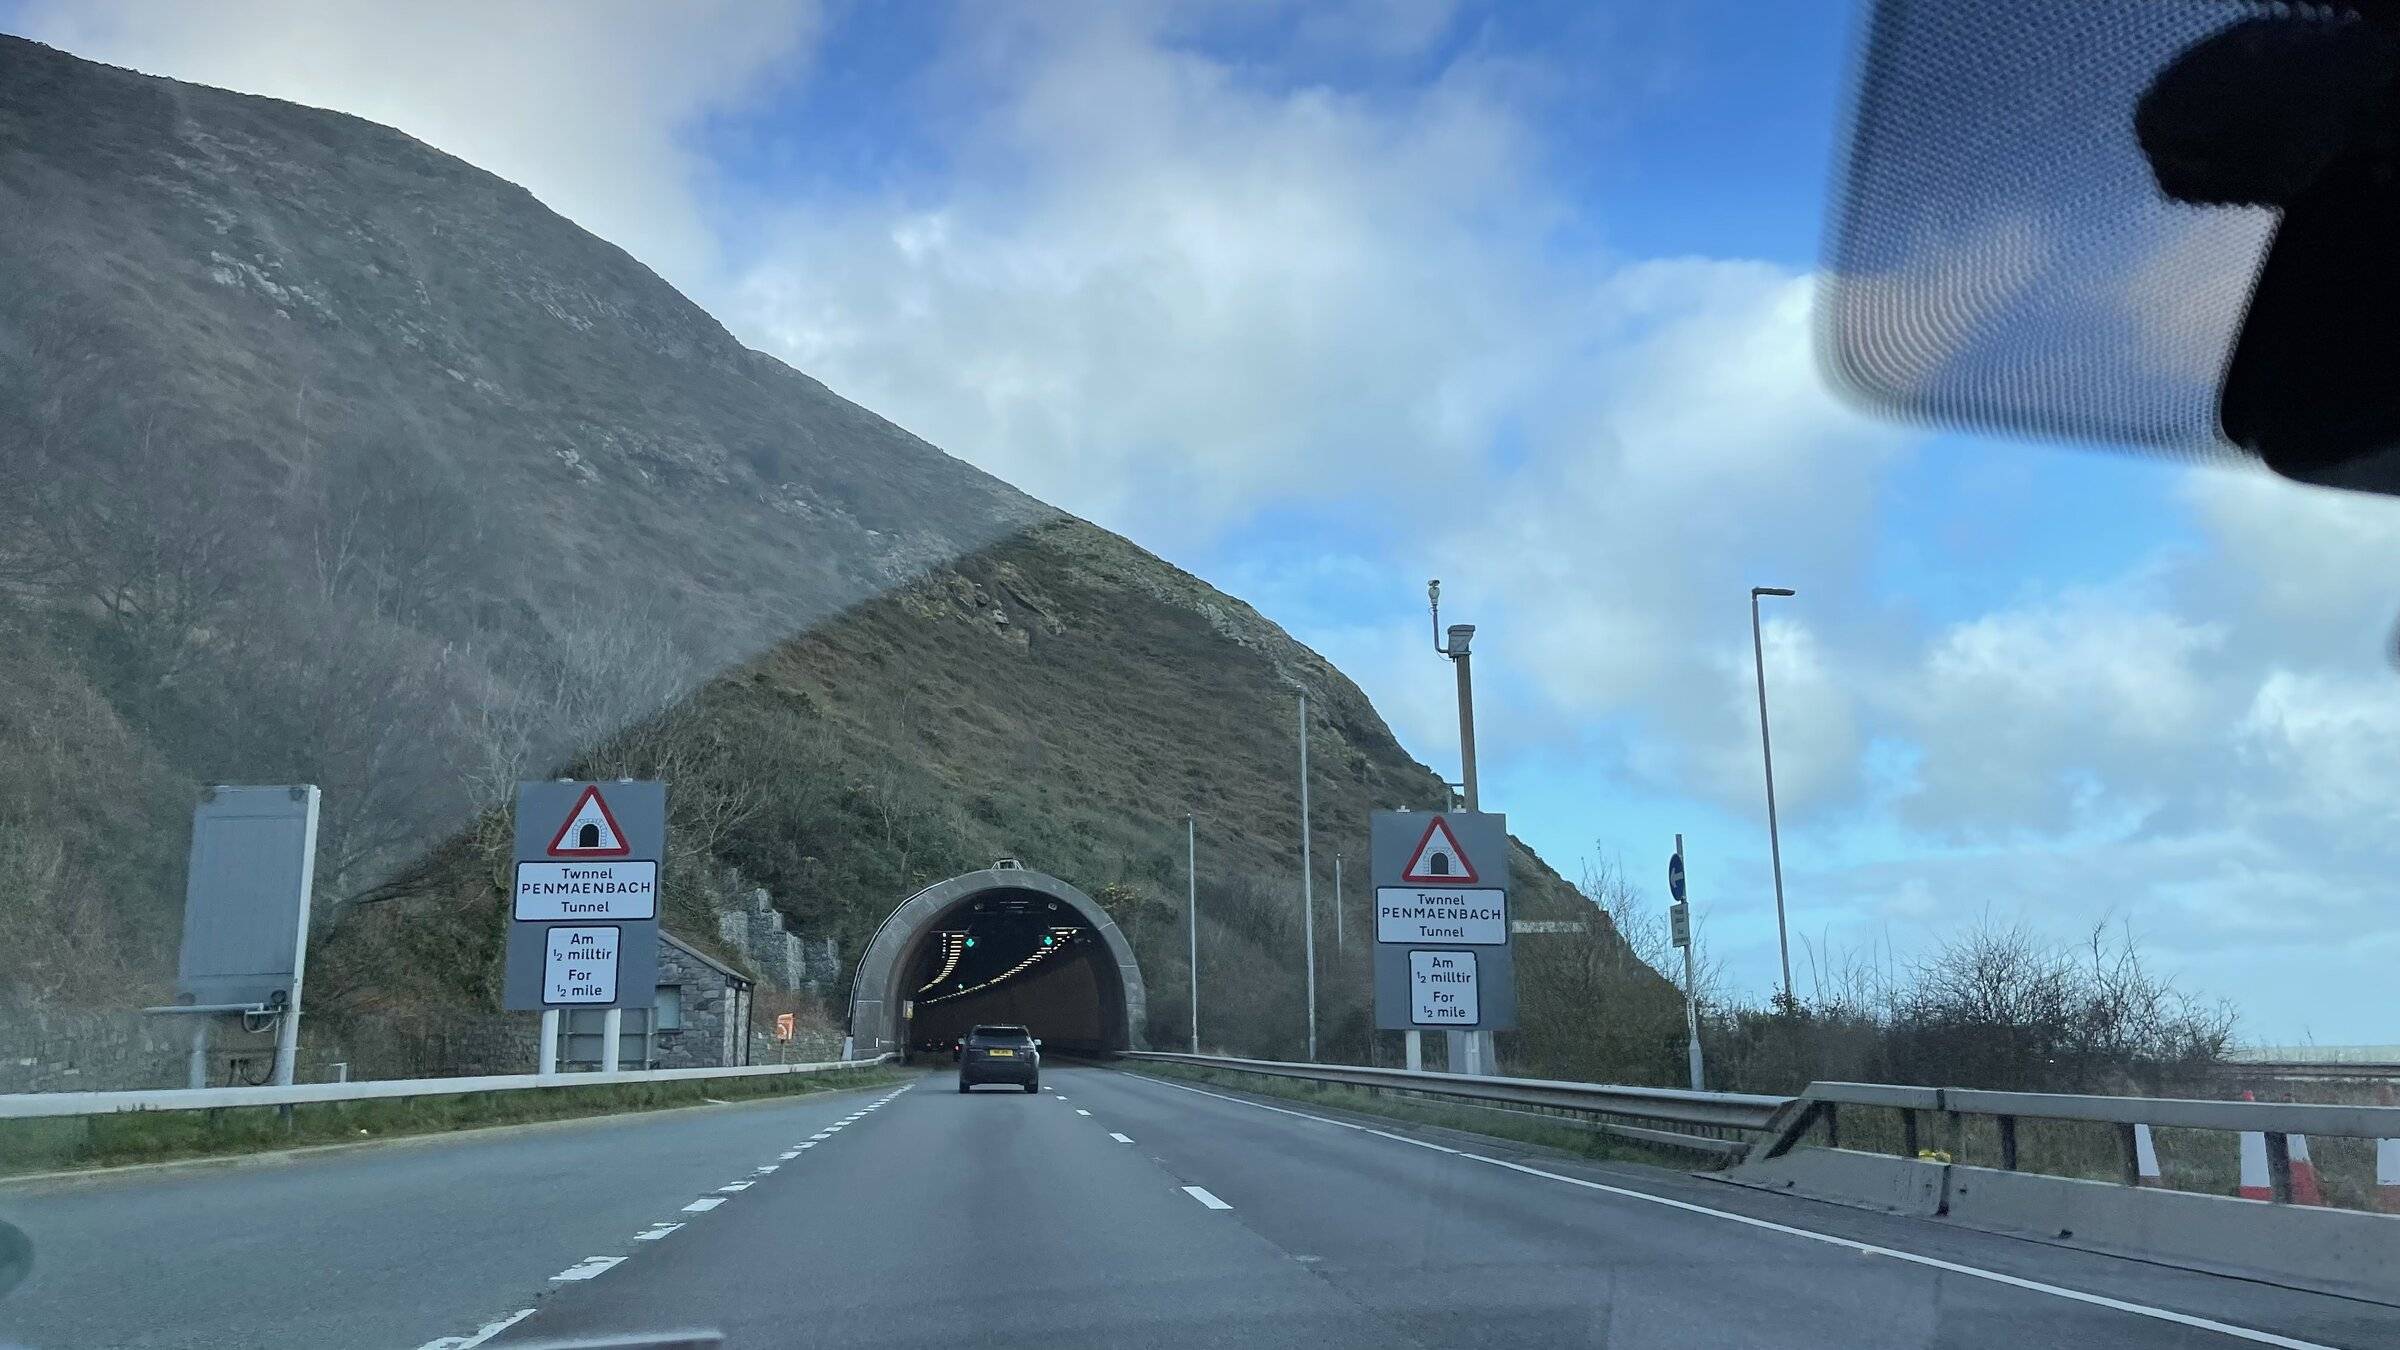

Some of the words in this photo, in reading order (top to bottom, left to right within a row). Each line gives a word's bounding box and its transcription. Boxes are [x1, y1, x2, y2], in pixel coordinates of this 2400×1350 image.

[562, 868, 612, 880] Twnnel
[521, 882, 651, 894] PENMAENBACH
[1417, 894, 1465, 905] Twnnel
[562, 901, 609, 913] Tunnel
[1382, 908, 1501, 920] PENMAENBACH
[1419, 926, 1464, 937] Tunnel
[570, 934, 594, 945] Am
[567, 948, 612, 960] milltir
[1432, 957, 1454, 968] Am
[568, 969, 591, 981] For
[1431, 972, 1471, 983] milltir
[571, 985, 602, 996] mile
[1433, 992, 1454, 1002] For
[1437, 1006, 1466, 1017] mile
